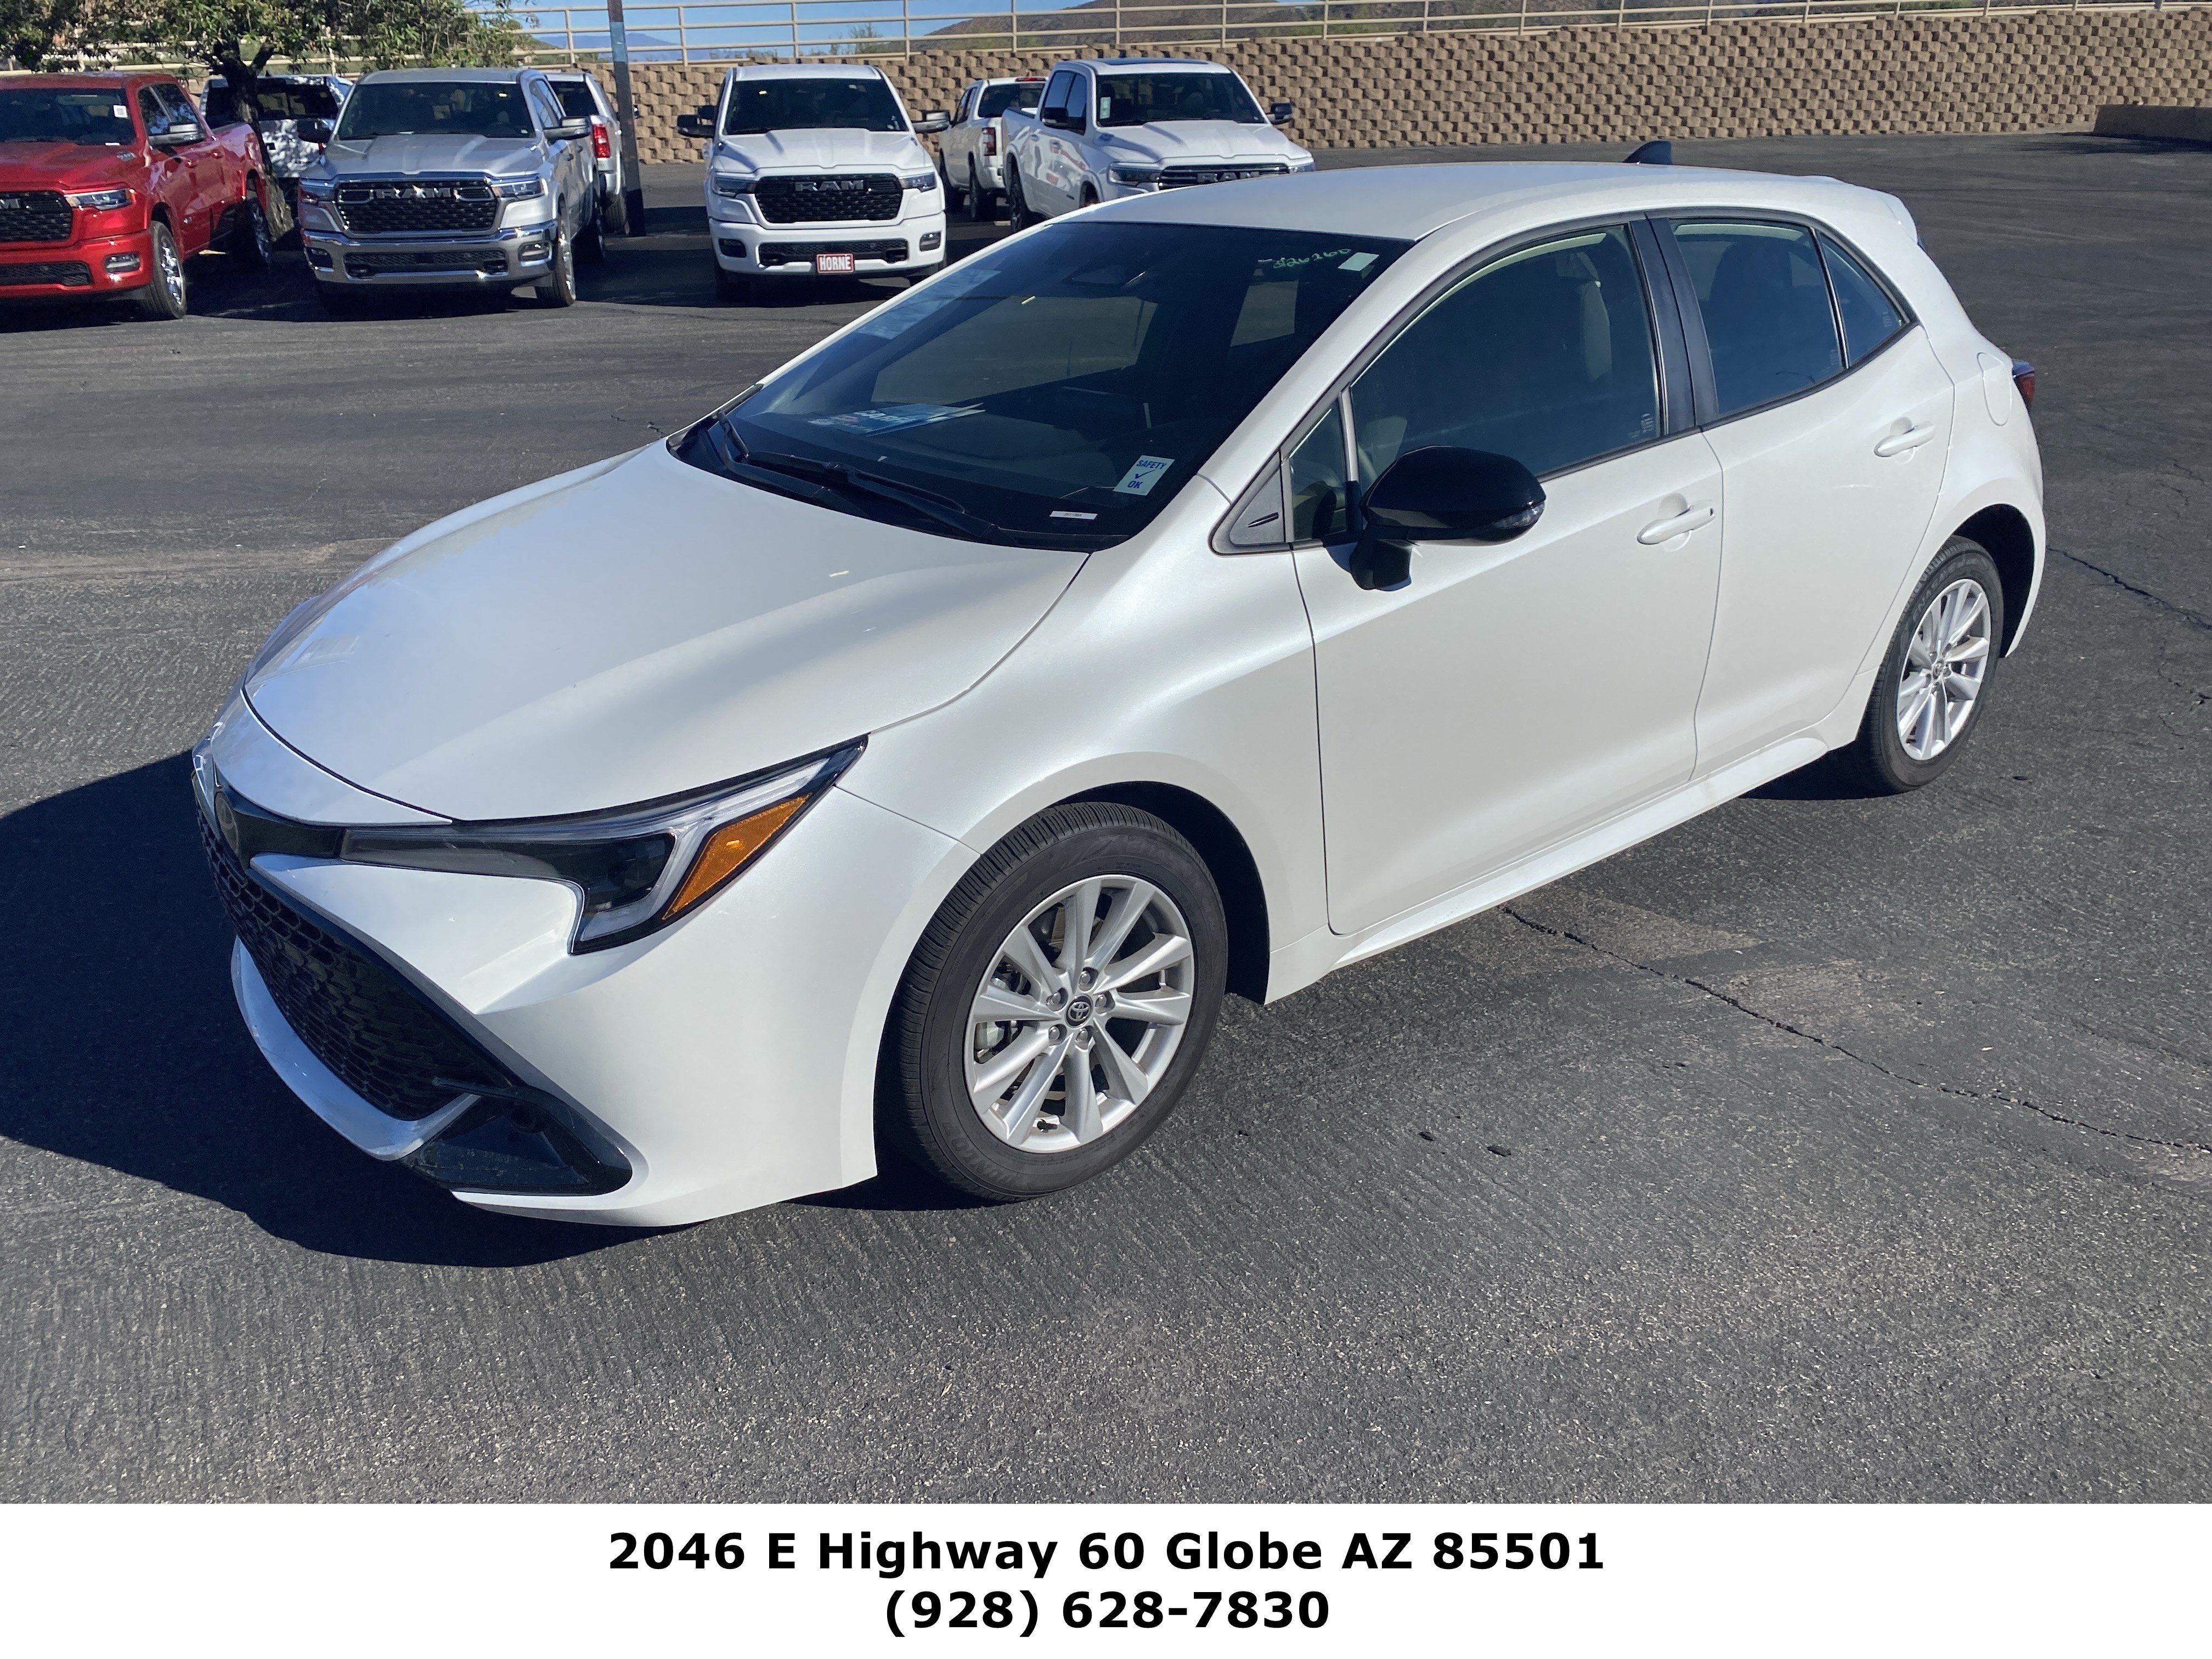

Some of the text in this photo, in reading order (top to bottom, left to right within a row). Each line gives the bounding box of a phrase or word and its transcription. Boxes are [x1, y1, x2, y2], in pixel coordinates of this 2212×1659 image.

[795, 180, 864, 191] RAM
[376, 188, 451, 199] RAM
[820, 256, 851, 270] HORNE
[1136, 460, 1167, 470] SAFETY
[1127, 481, 1143, 489] OK
